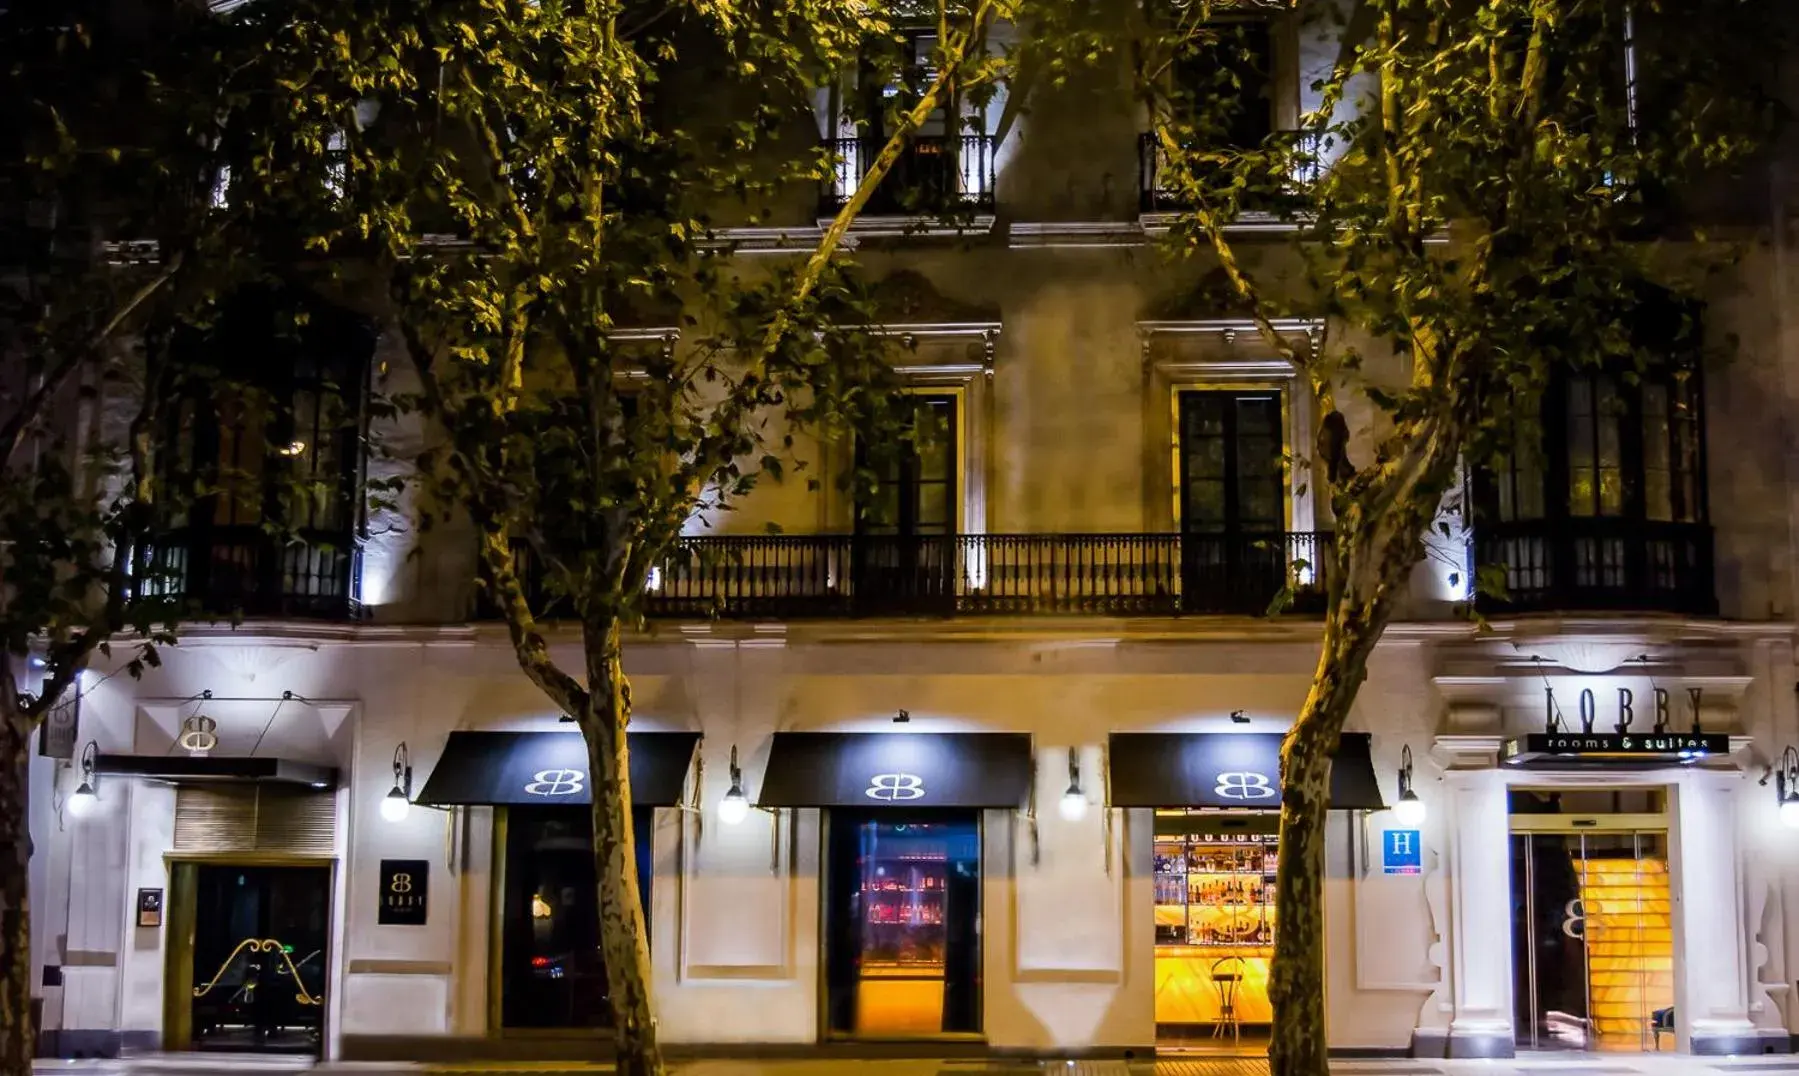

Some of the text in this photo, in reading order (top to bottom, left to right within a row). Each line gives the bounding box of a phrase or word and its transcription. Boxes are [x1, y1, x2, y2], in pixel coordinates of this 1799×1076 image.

[1544, 687, 1703, 727] LOBBY
[1547, 736, 1709, 750] rooms & suites
[1391, 831, 1413, 856] H
